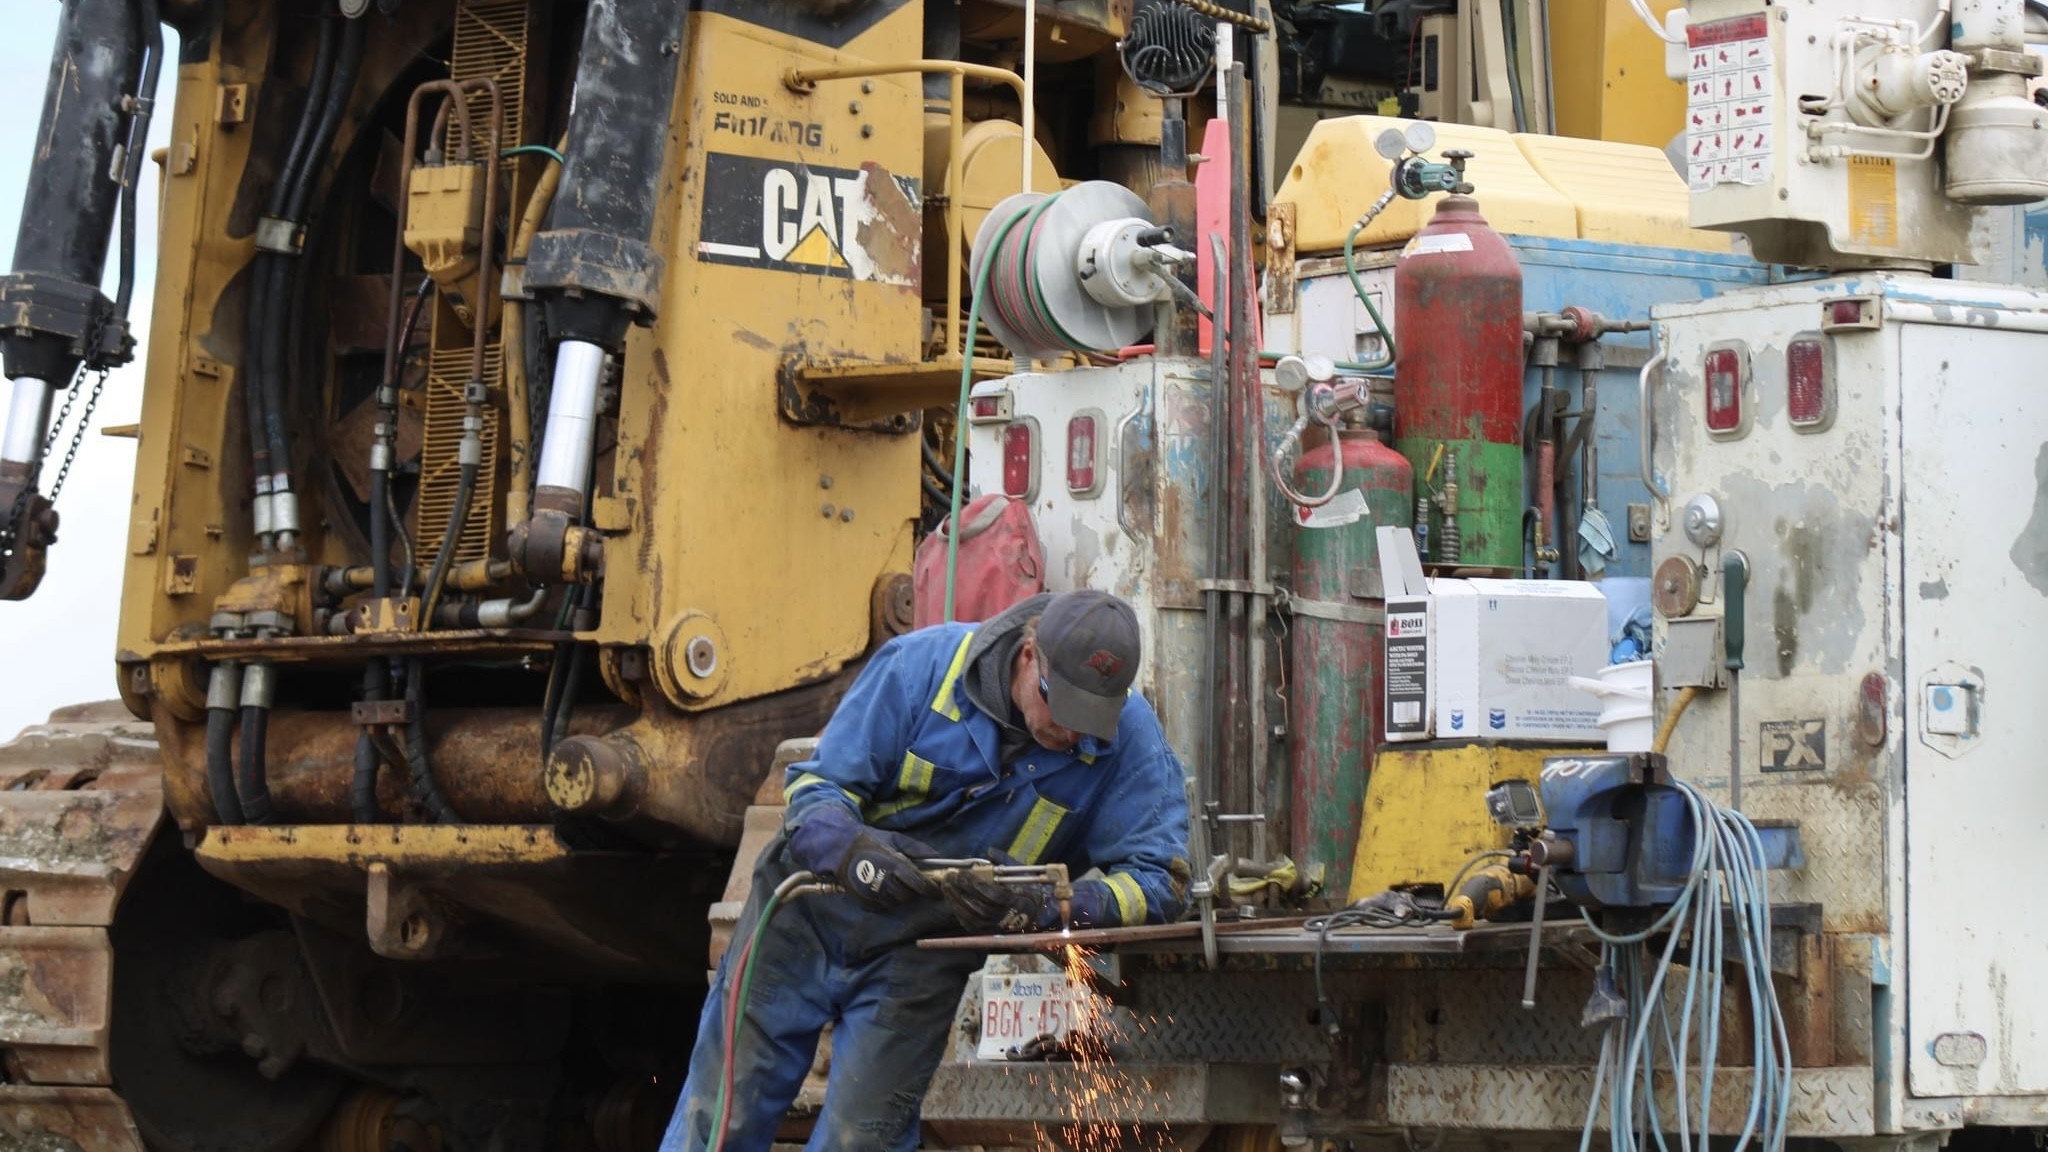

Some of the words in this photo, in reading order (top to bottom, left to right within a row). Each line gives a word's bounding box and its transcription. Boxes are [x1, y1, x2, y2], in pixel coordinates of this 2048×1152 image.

[713, 92, 737, 104] SOLD
[740, 95, 761, 107] AND
[763, 168, 869, 279] CAT
